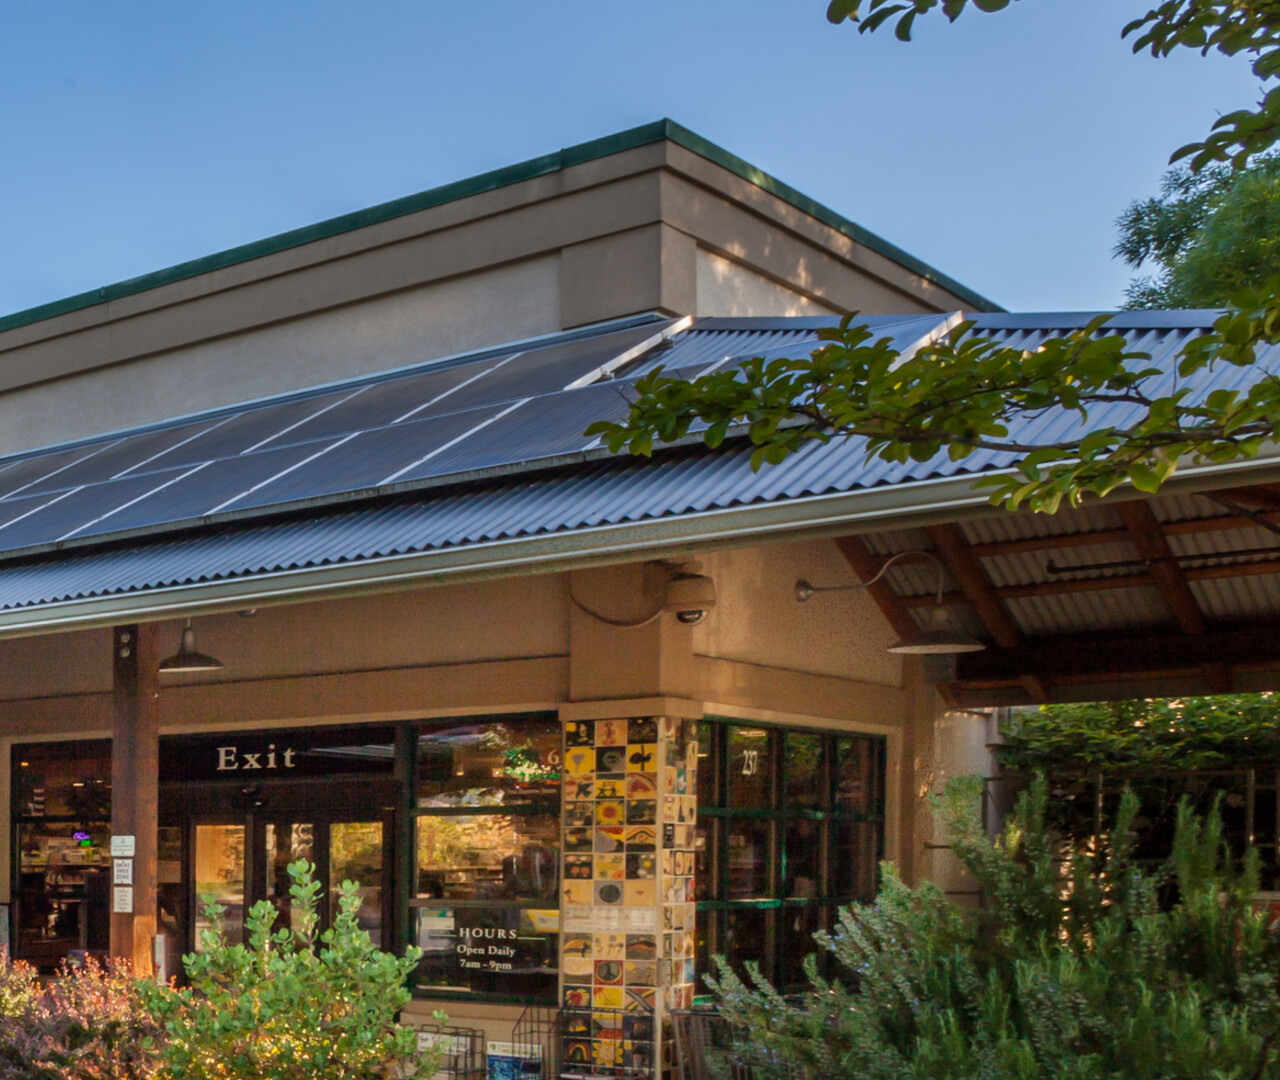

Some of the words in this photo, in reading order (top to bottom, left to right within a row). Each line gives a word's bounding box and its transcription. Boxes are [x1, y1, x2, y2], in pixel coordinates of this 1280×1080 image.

[216, 744, 296, 771] Exit
[742, 750, 758, 776] 237
[459, 927, 518, 939] HOURS
[456, 945, 485, 956] Open
[488, 946, 516, 957] Daily
[459, 959, 481, 969] 7am
[489, 960, 513, 971] 9pm
